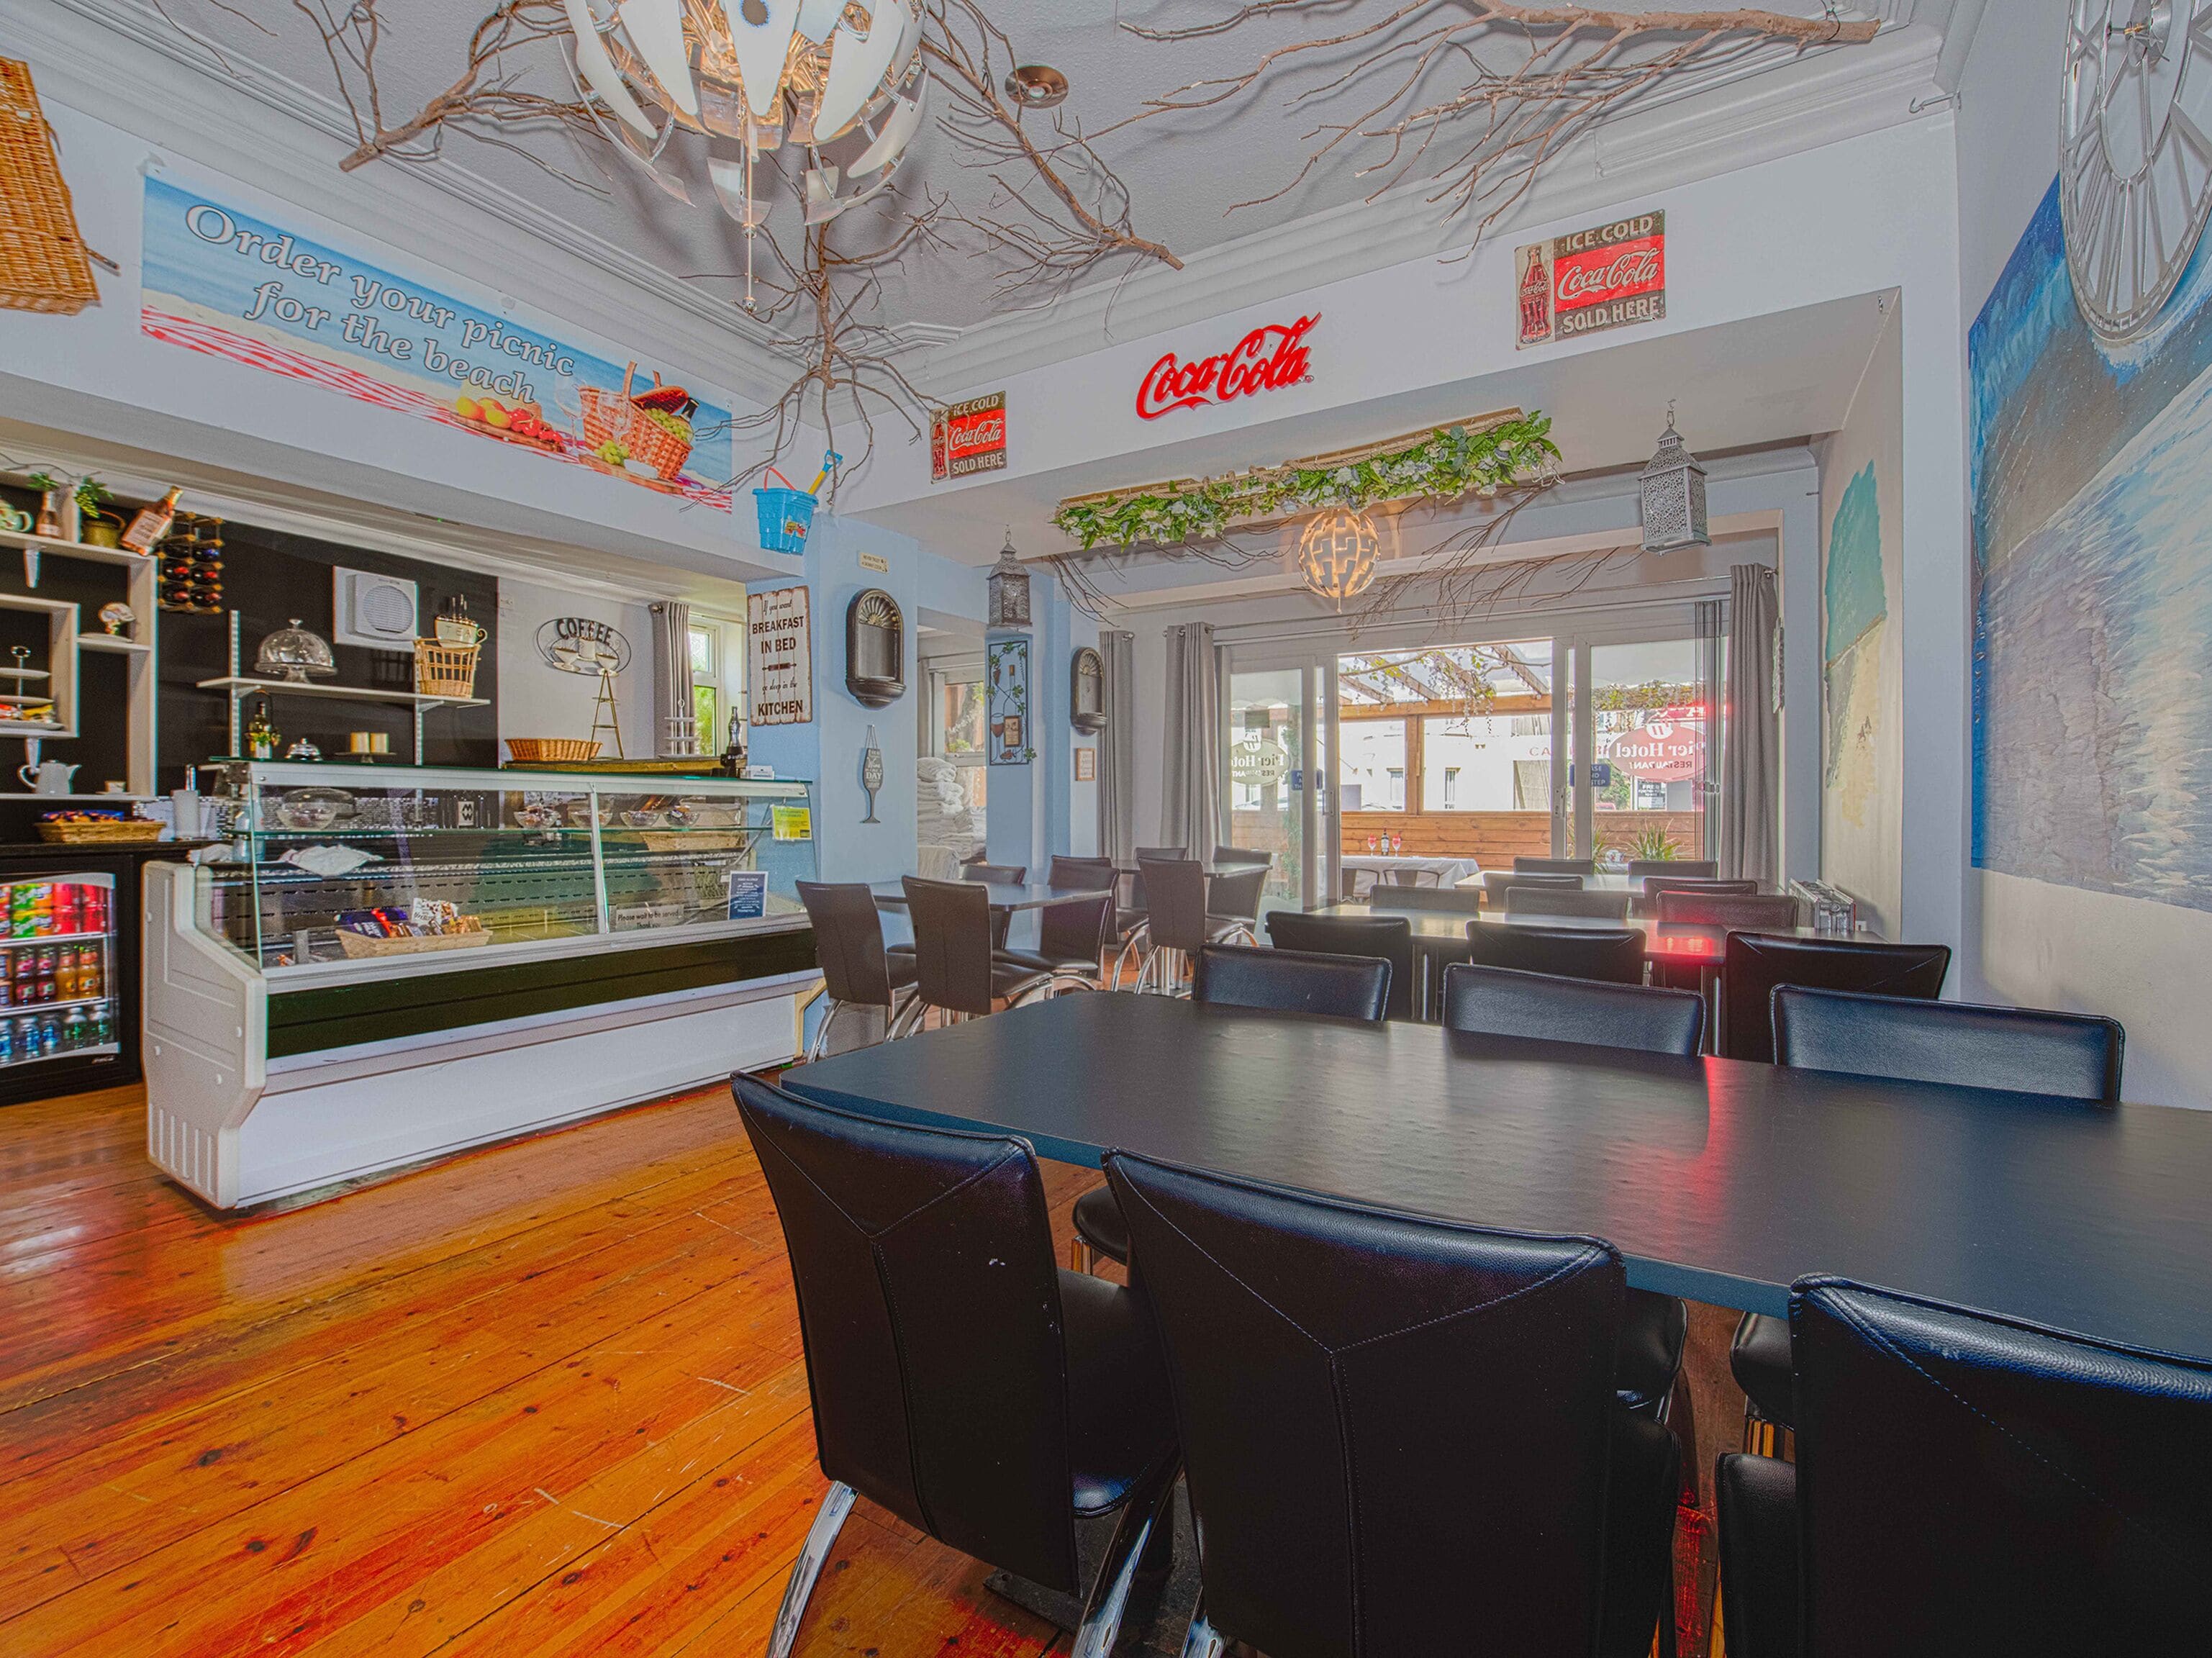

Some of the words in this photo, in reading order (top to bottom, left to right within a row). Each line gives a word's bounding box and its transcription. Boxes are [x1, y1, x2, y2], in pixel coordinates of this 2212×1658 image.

[1566, 230, 1595, 252] ICE
[1601, 216, 1654, 241] COLD
[1556, 248, 1661, 300] Coca-Cola
[186, 204, 342, 286] Order
[351, 275, 455, 330] your
[463, 318, 575, 376] picnic
[1562, 308, 1608, 334] SOLD
[1612, 296, 1660, 322] HERE
[244, 281, 330, 330] for
[341, 314, 413, 361] the
[423, 338, 535, 404] beach
[1136, 312, 1322, 420] Coca-Cola
[953, 403, 969, 416] ICE
[971, 395, 999, 412] COLD
[953, 458, 976, 475] SOLD
[978, 452, 1004, 469] HERE
[445, 625, 472, 639] TEA
[556, 618, 615, 646] COFFEE
[753, 615, 804, 635] BREAKFAST
[761, 639, 772, 654] IN
[775, 637, 797, 652] BED
[758, 699, 804, 717] KITCHEN
